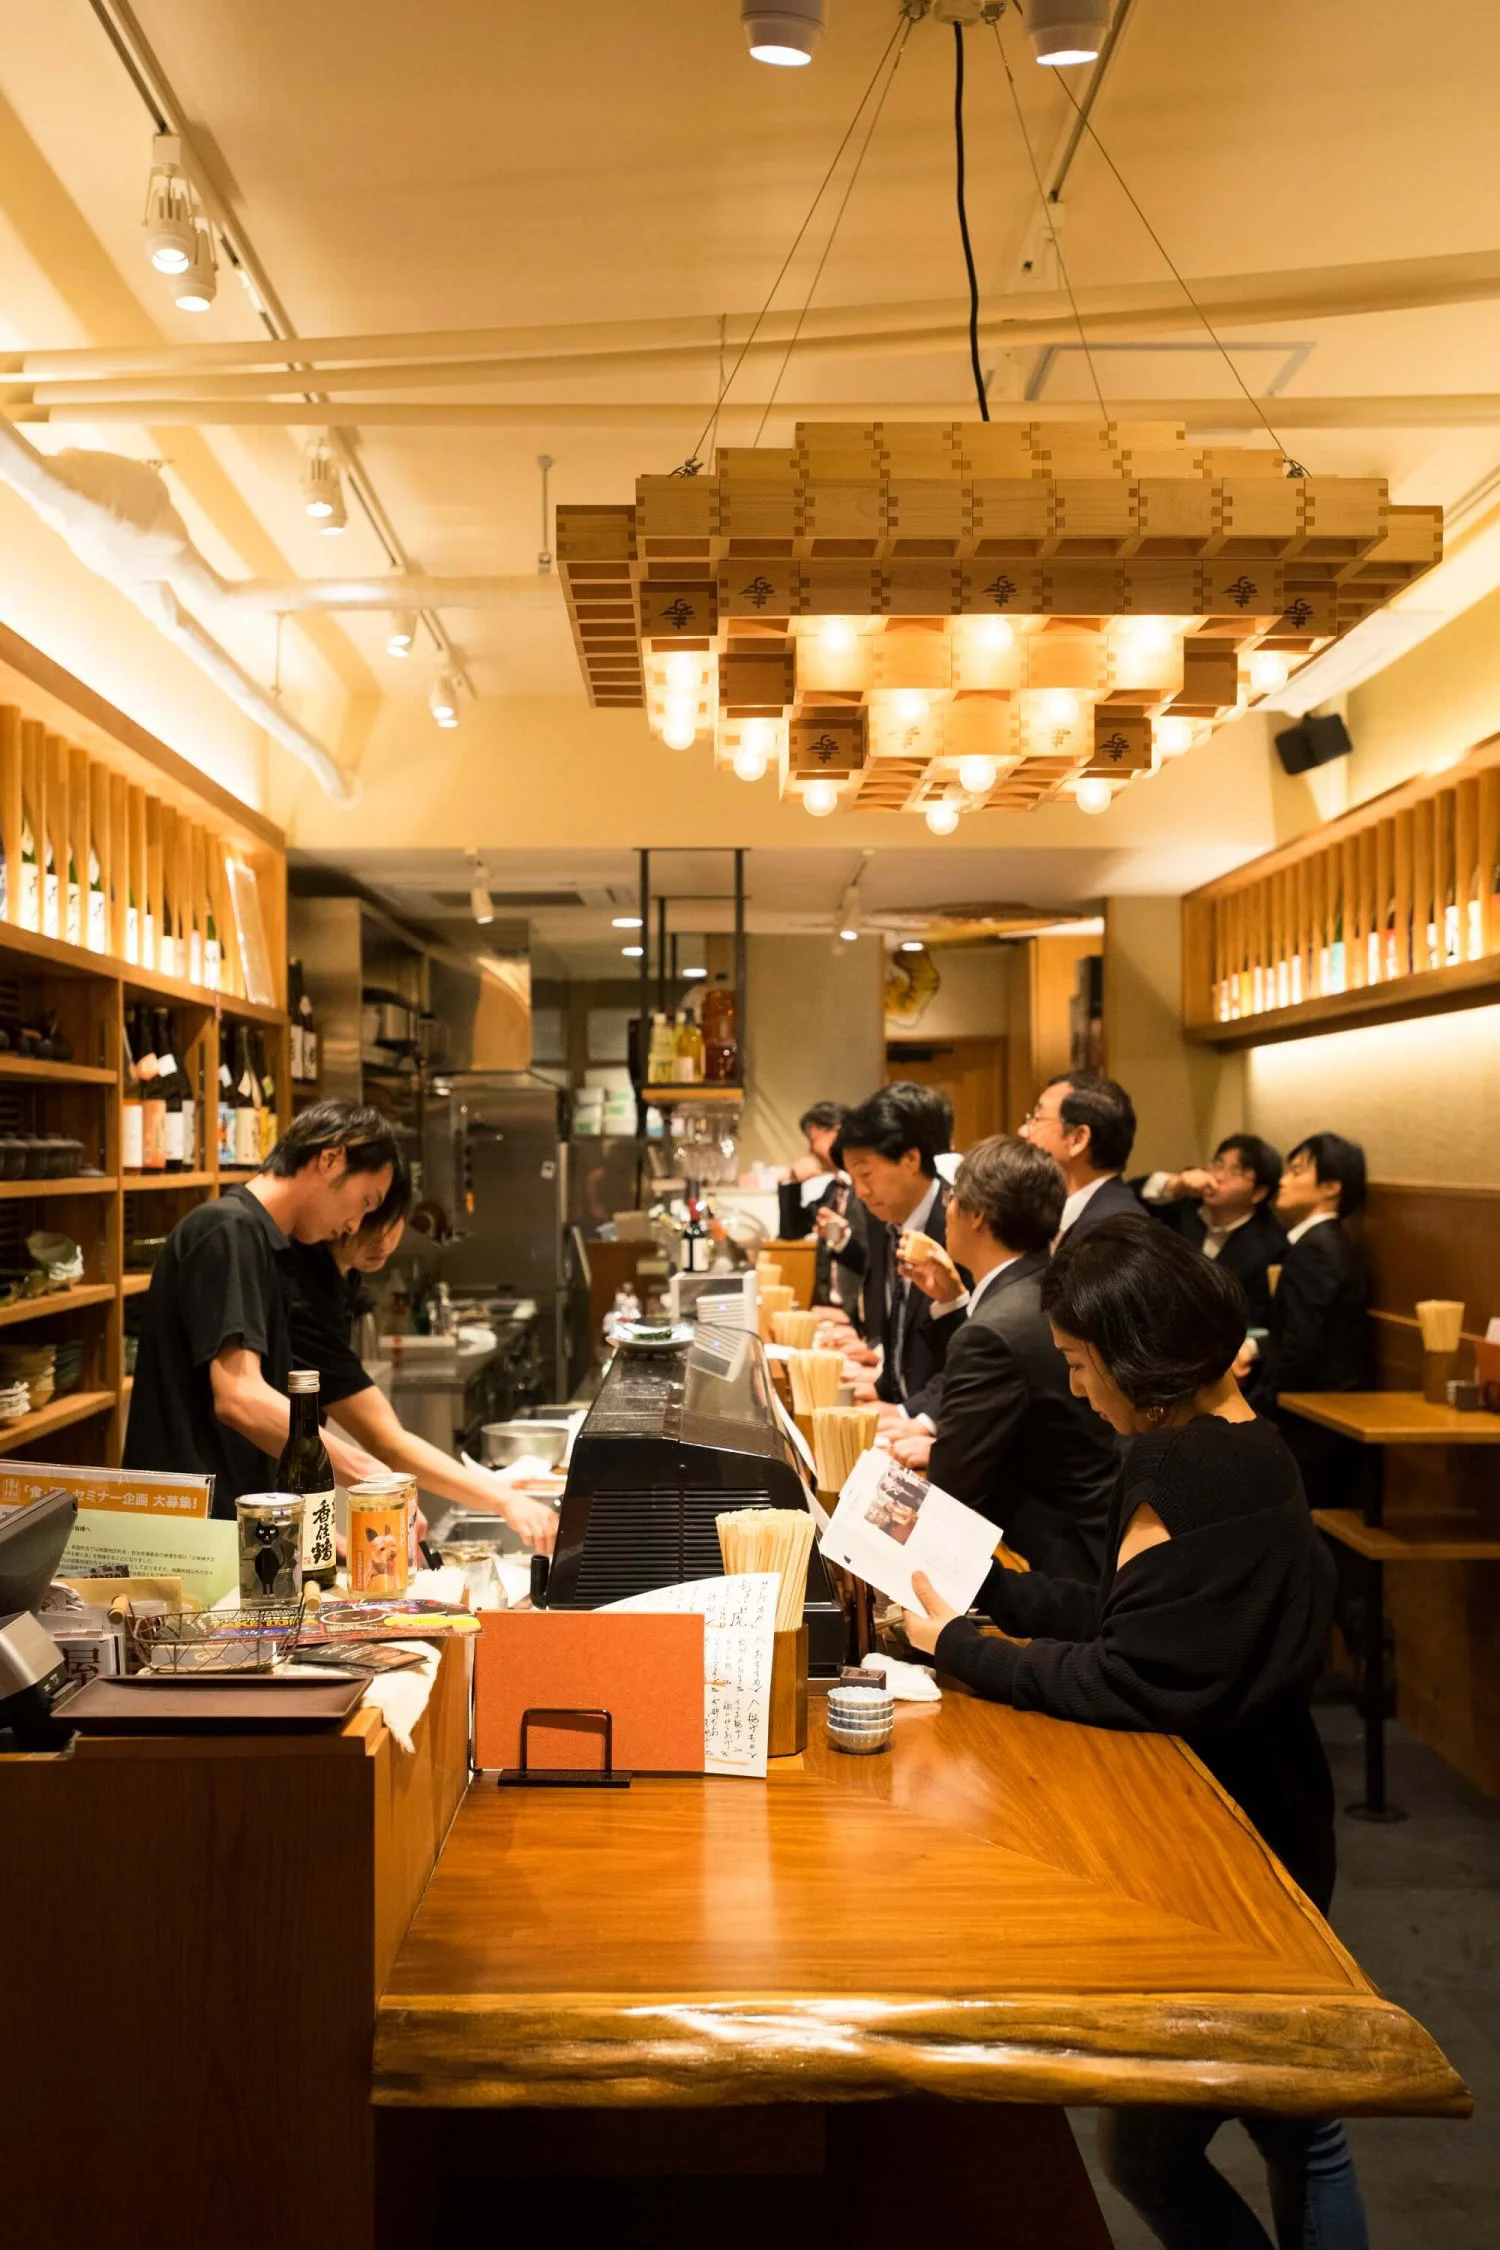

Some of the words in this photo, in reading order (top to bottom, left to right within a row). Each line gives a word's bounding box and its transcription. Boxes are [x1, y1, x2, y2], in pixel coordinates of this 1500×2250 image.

[73, 1488, 148, 1507] セミナー企画
[311, 1499, 333, 1565] 香住鶴
